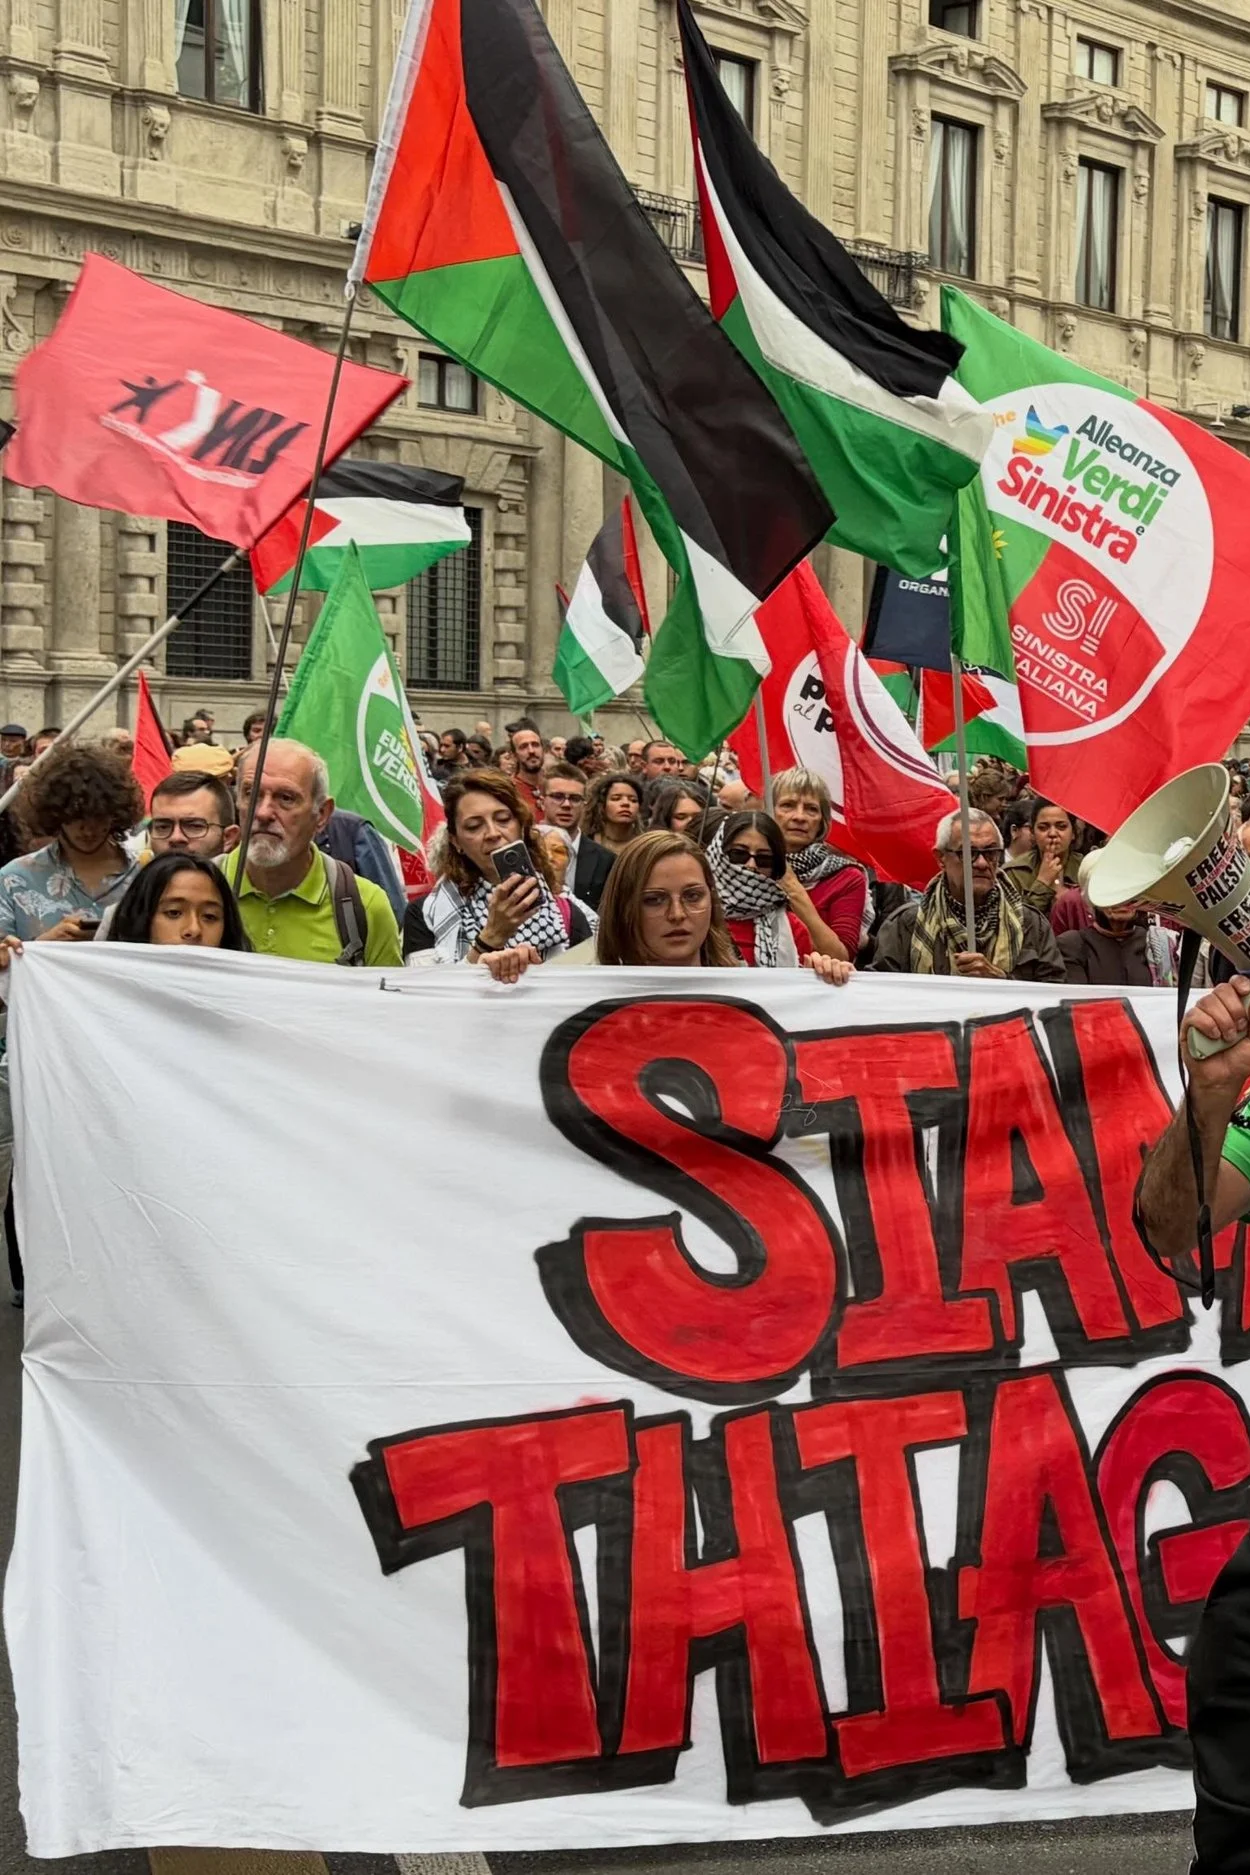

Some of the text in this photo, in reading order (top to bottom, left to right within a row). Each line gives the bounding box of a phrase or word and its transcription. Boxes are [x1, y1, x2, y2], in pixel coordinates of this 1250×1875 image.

[1062, 437, 1169, 526] Verdi
[1076, 414, 1182, 488] Alleanza
[996, 456, 1138, 564] Sinistra
[1135, 525, 1145, 536] e
[898, 579, 950, 597] ORGAN
[1011, 624, 1108, 696] SINISTRA
[373, 744, 421, 800] VERD
[1195, 847, 1248, 910] PALESTIN
